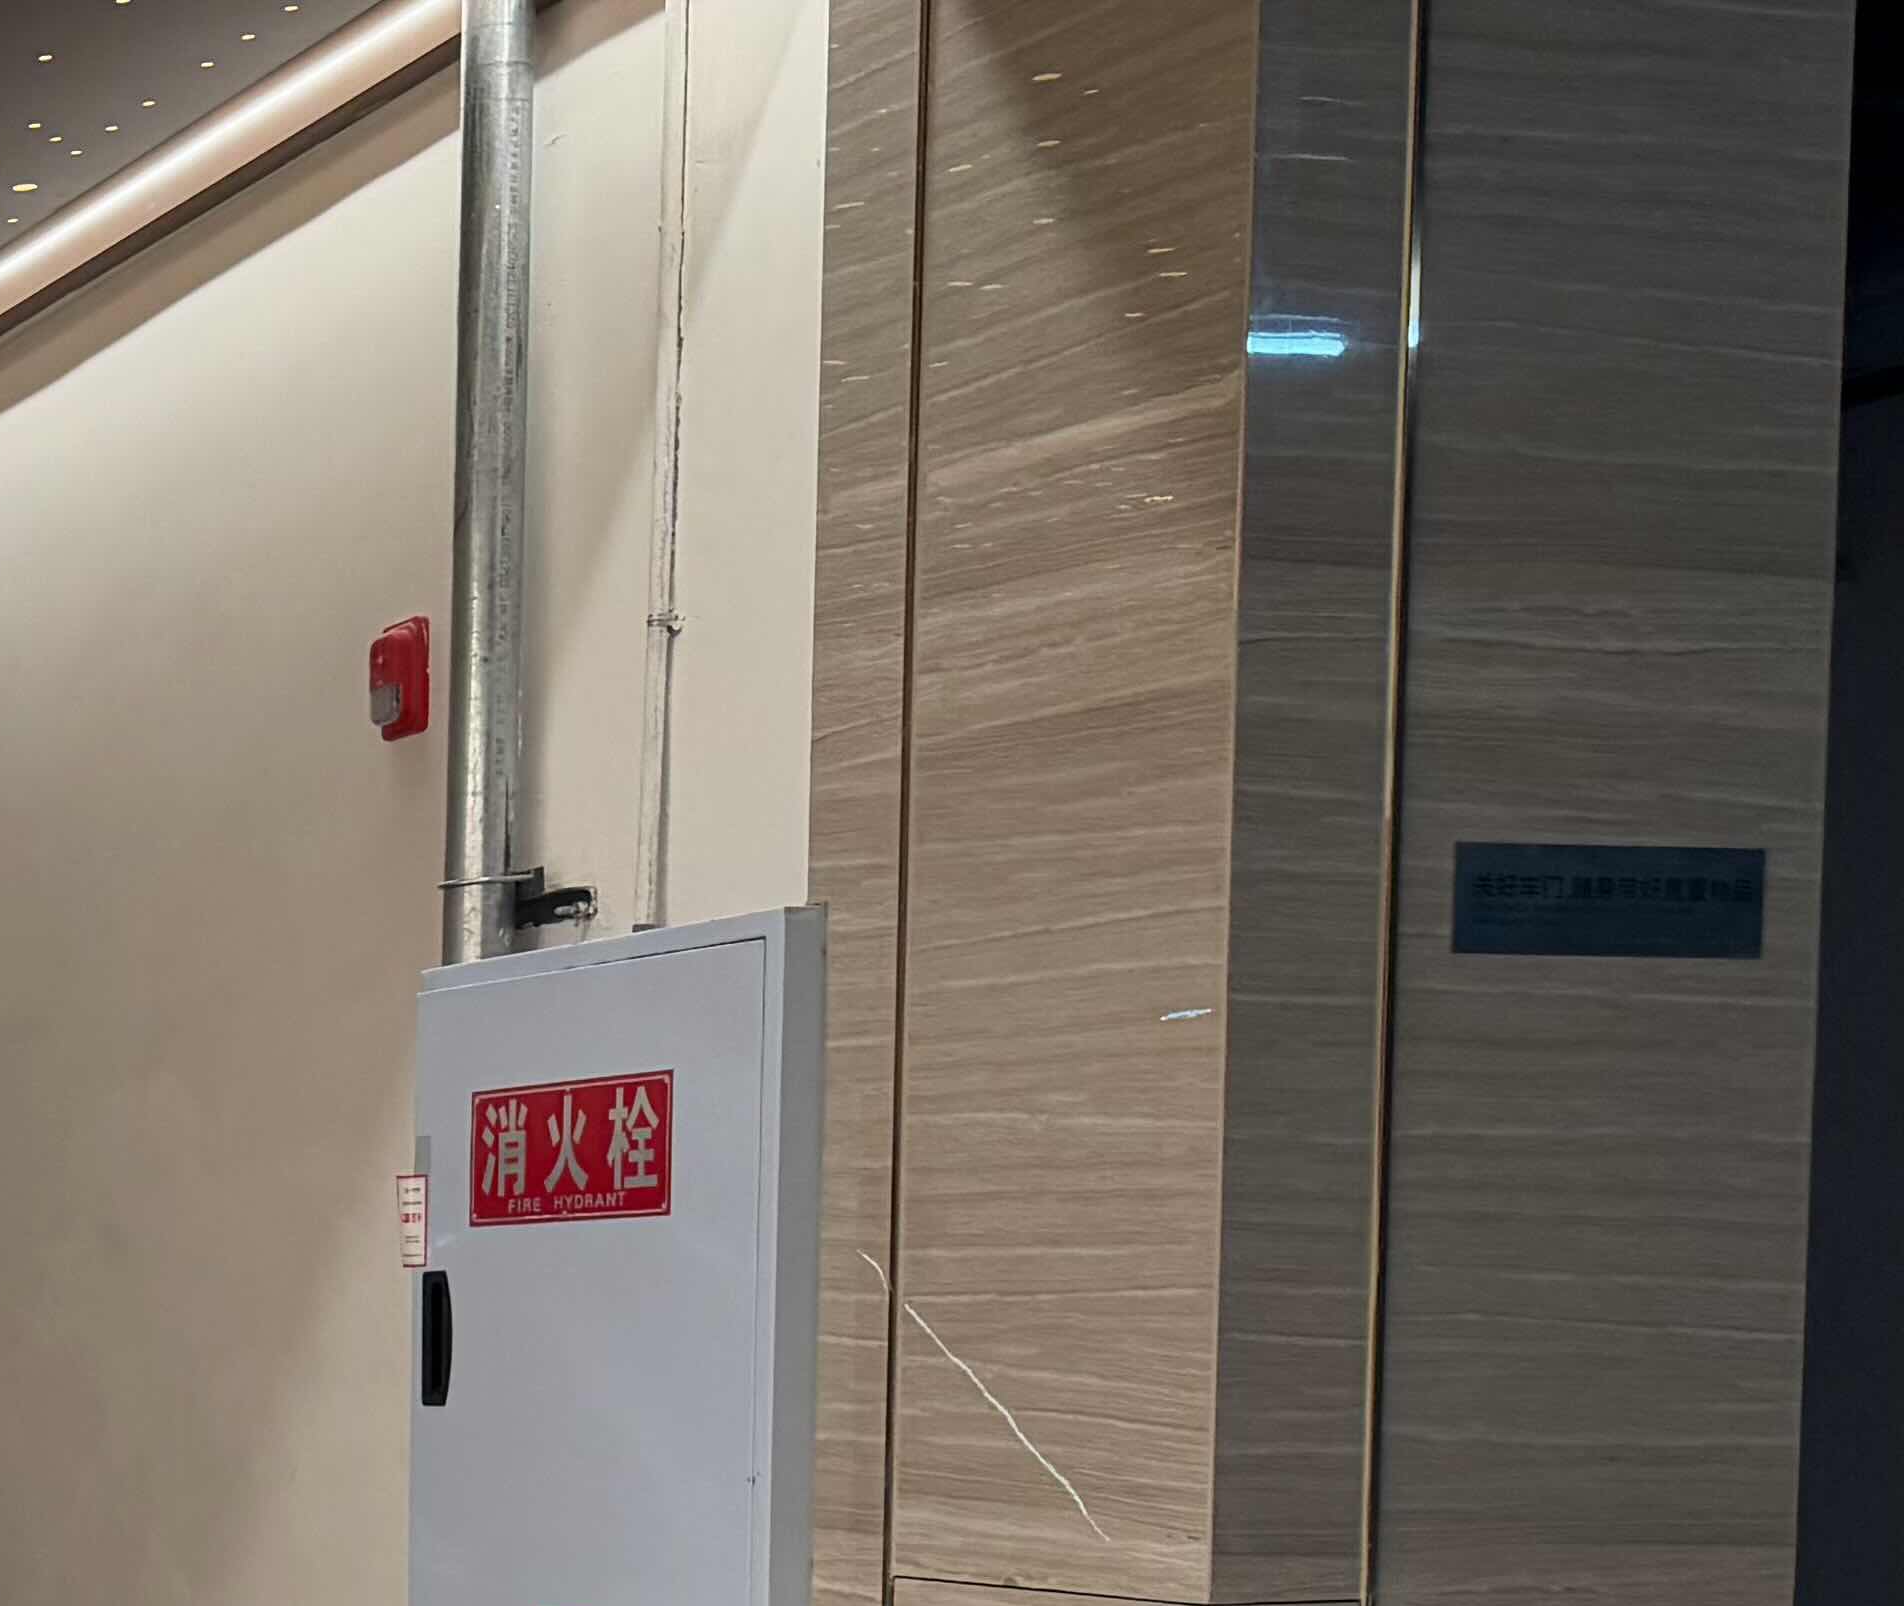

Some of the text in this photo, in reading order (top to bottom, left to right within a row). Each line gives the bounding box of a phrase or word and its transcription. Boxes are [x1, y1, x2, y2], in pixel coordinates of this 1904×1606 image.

[481, 1086, 660, 1198] 消火栓
[508, 1191, 626, 1214] FIRE HYDRANT
